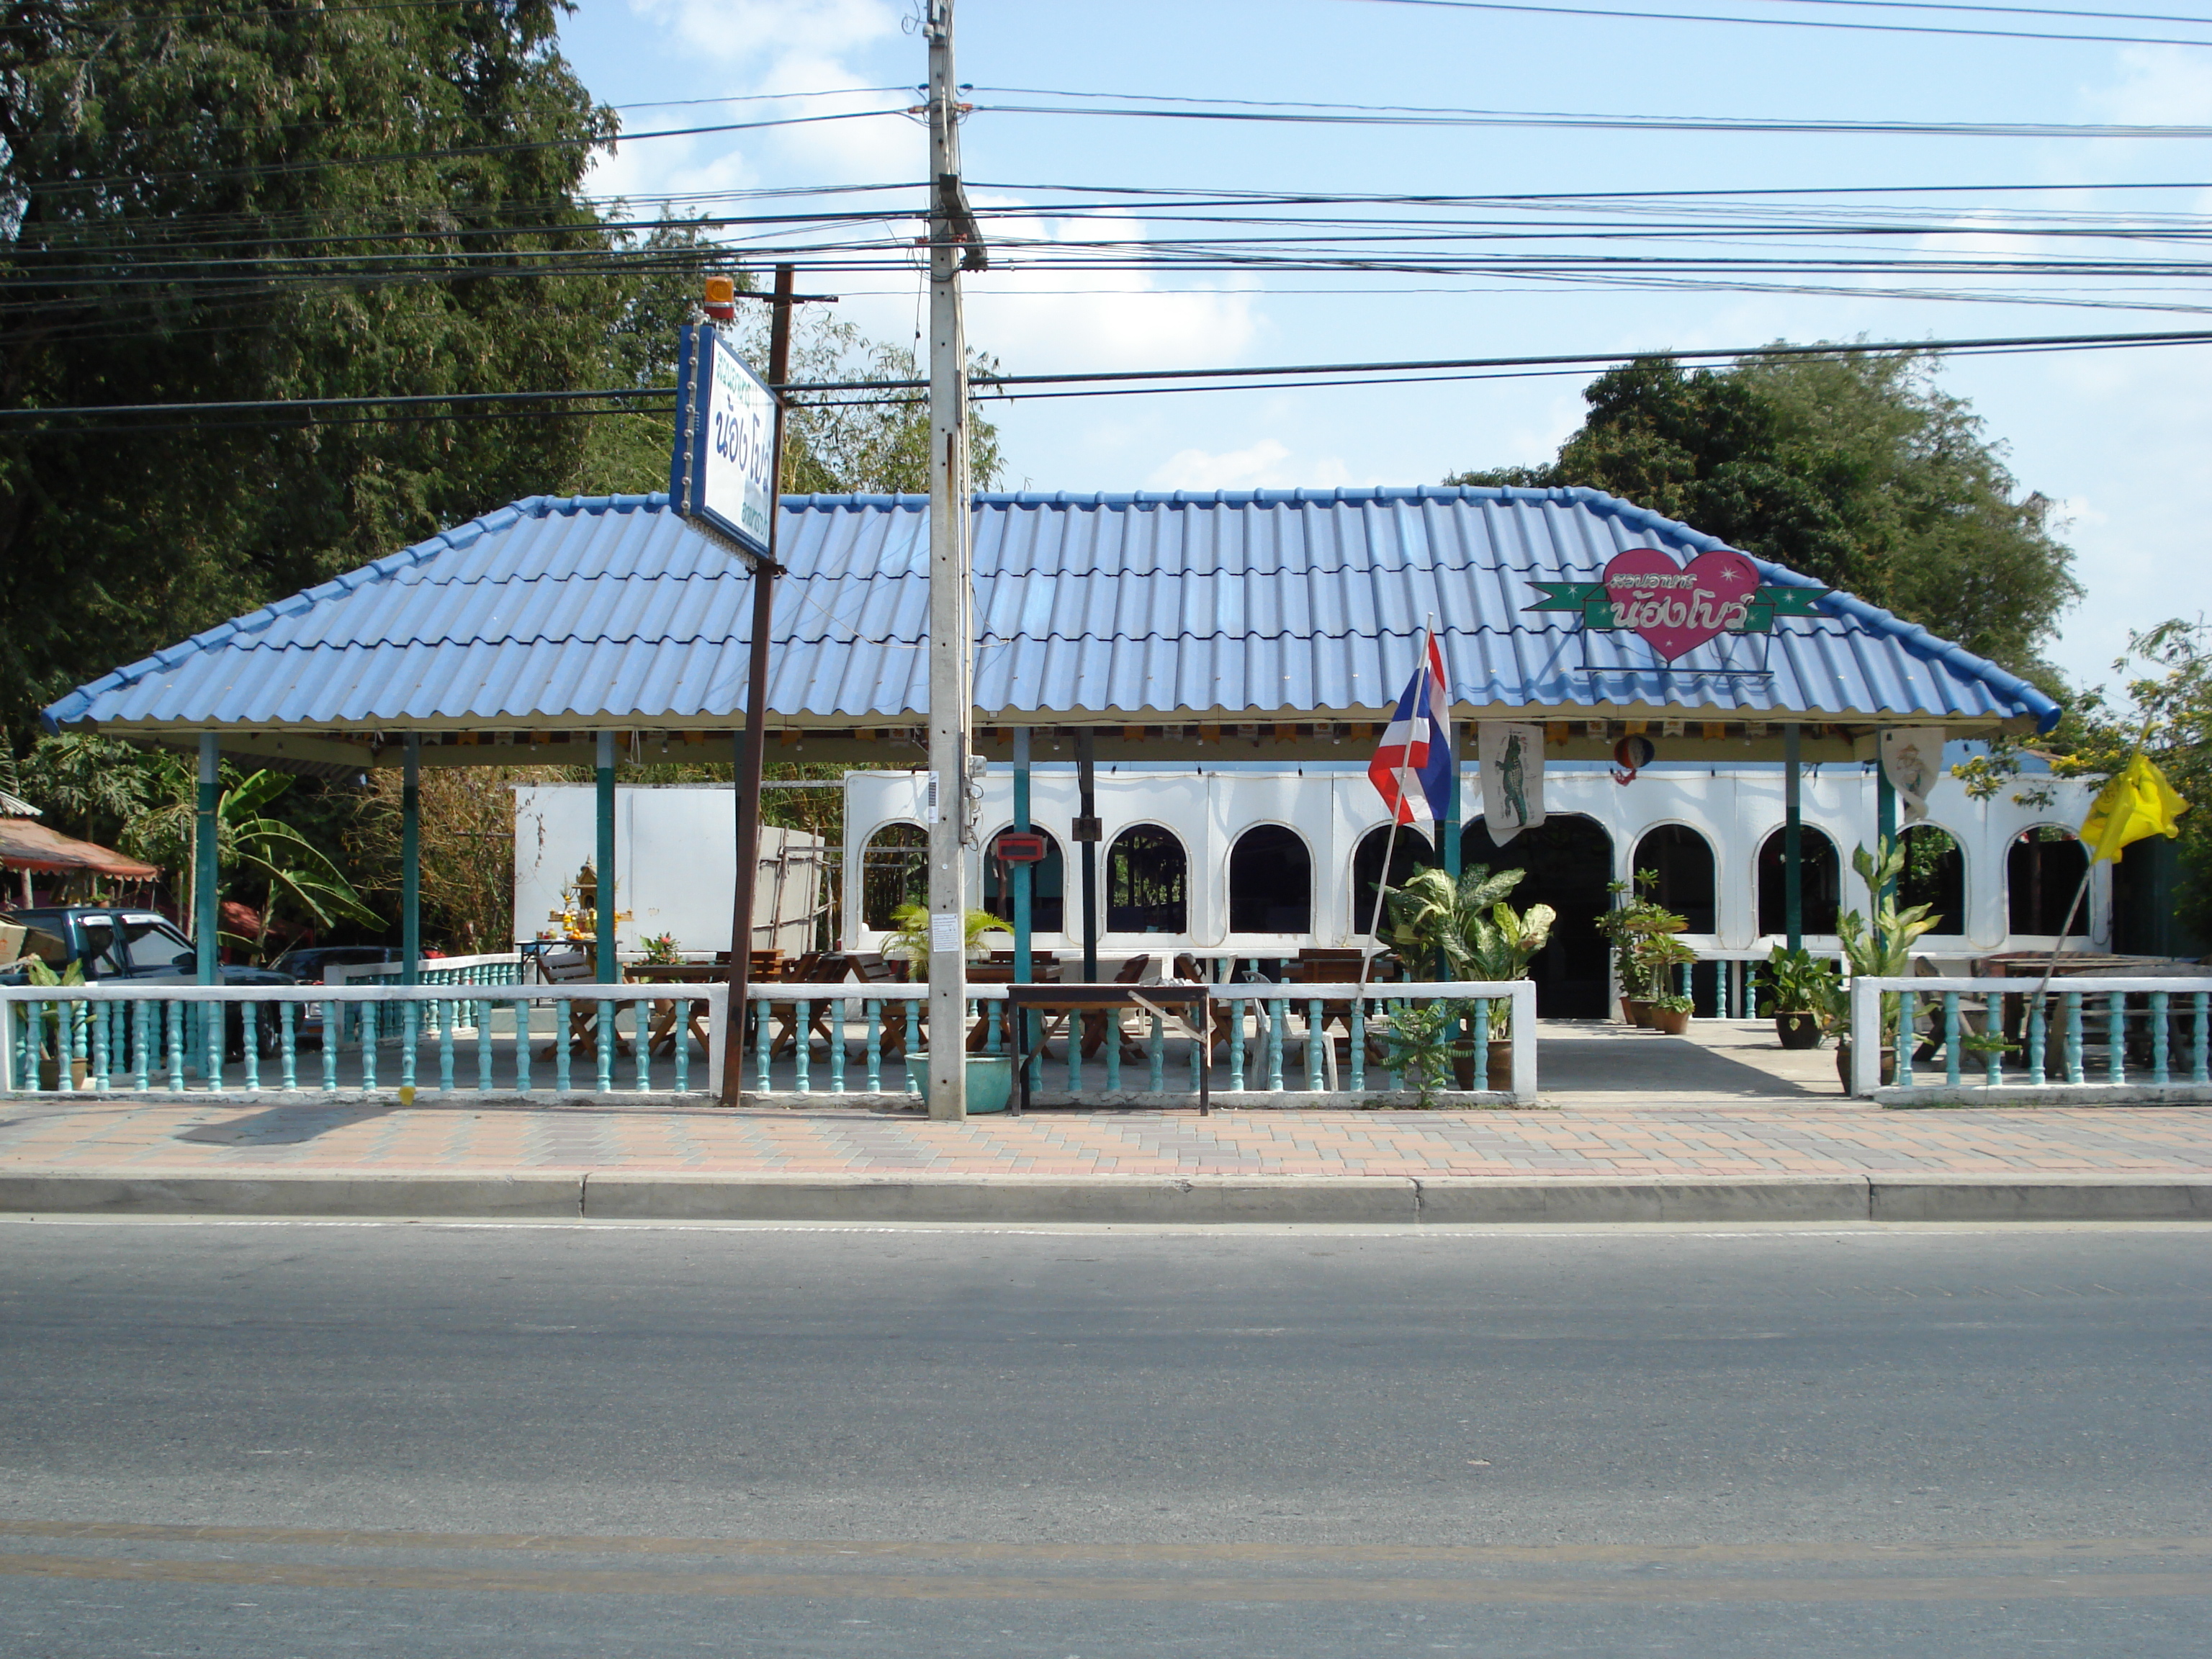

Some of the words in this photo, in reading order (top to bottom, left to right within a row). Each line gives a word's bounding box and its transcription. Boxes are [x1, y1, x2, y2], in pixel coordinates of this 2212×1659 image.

[1609, 572, 1698, 590] สวนอาหาร
[1610, 588, 1755, 629] น้องโบว์
